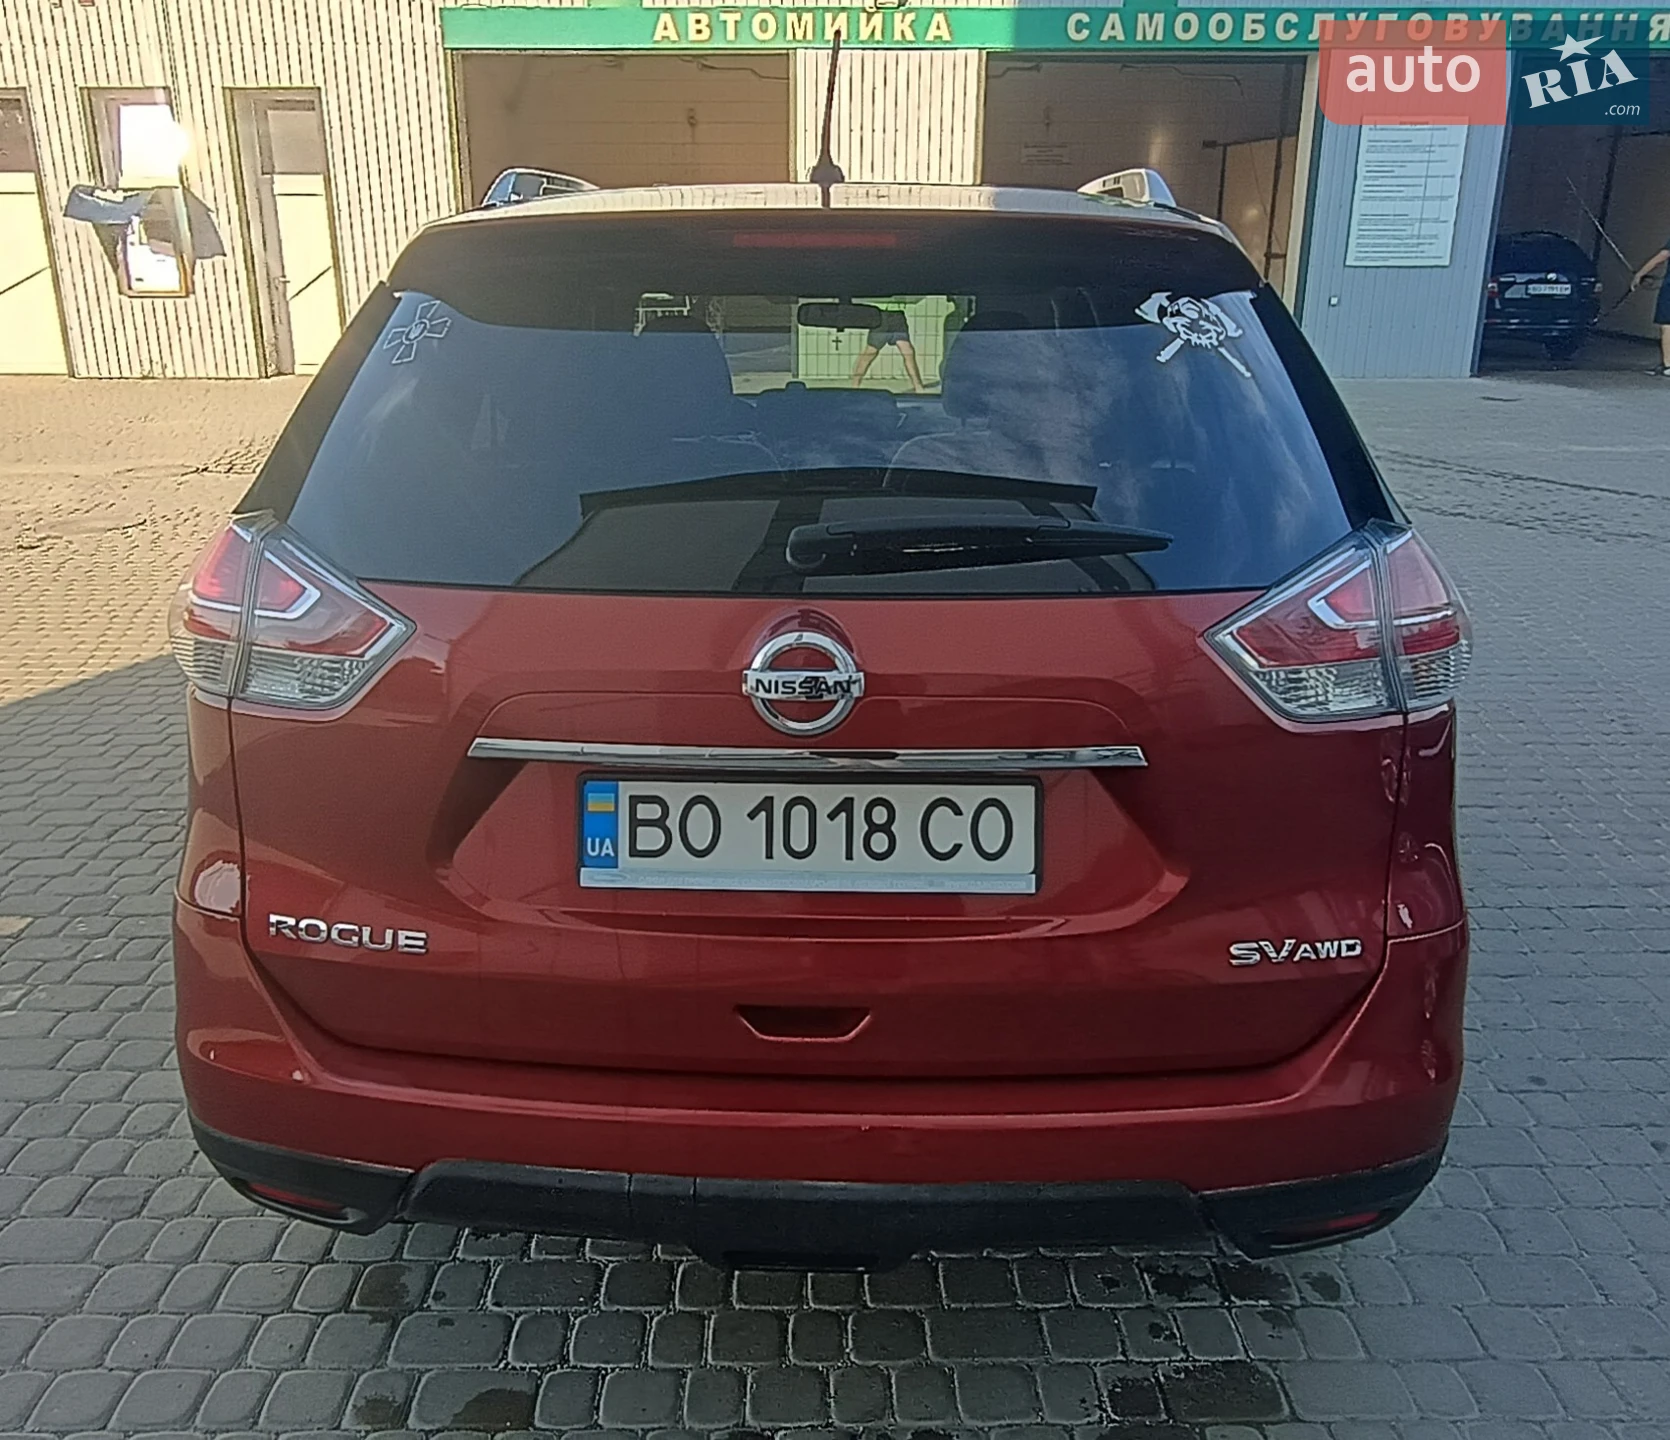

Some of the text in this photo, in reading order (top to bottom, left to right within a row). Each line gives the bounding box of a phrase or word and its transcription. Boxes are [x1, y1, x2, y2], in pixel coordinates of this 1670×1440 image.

[653, 7, 952, 41] АВТОМИЙКА
[1066, 12, 1670, 42] САМООБСЛУГОВУВАННЯ
[754, 677, 852, 696] NISSAN
[628, 794, 1014, 862] BO 1018 CO
[586, 837, 615, 857] UA
[268, 912, 429, 954] ROGUE
